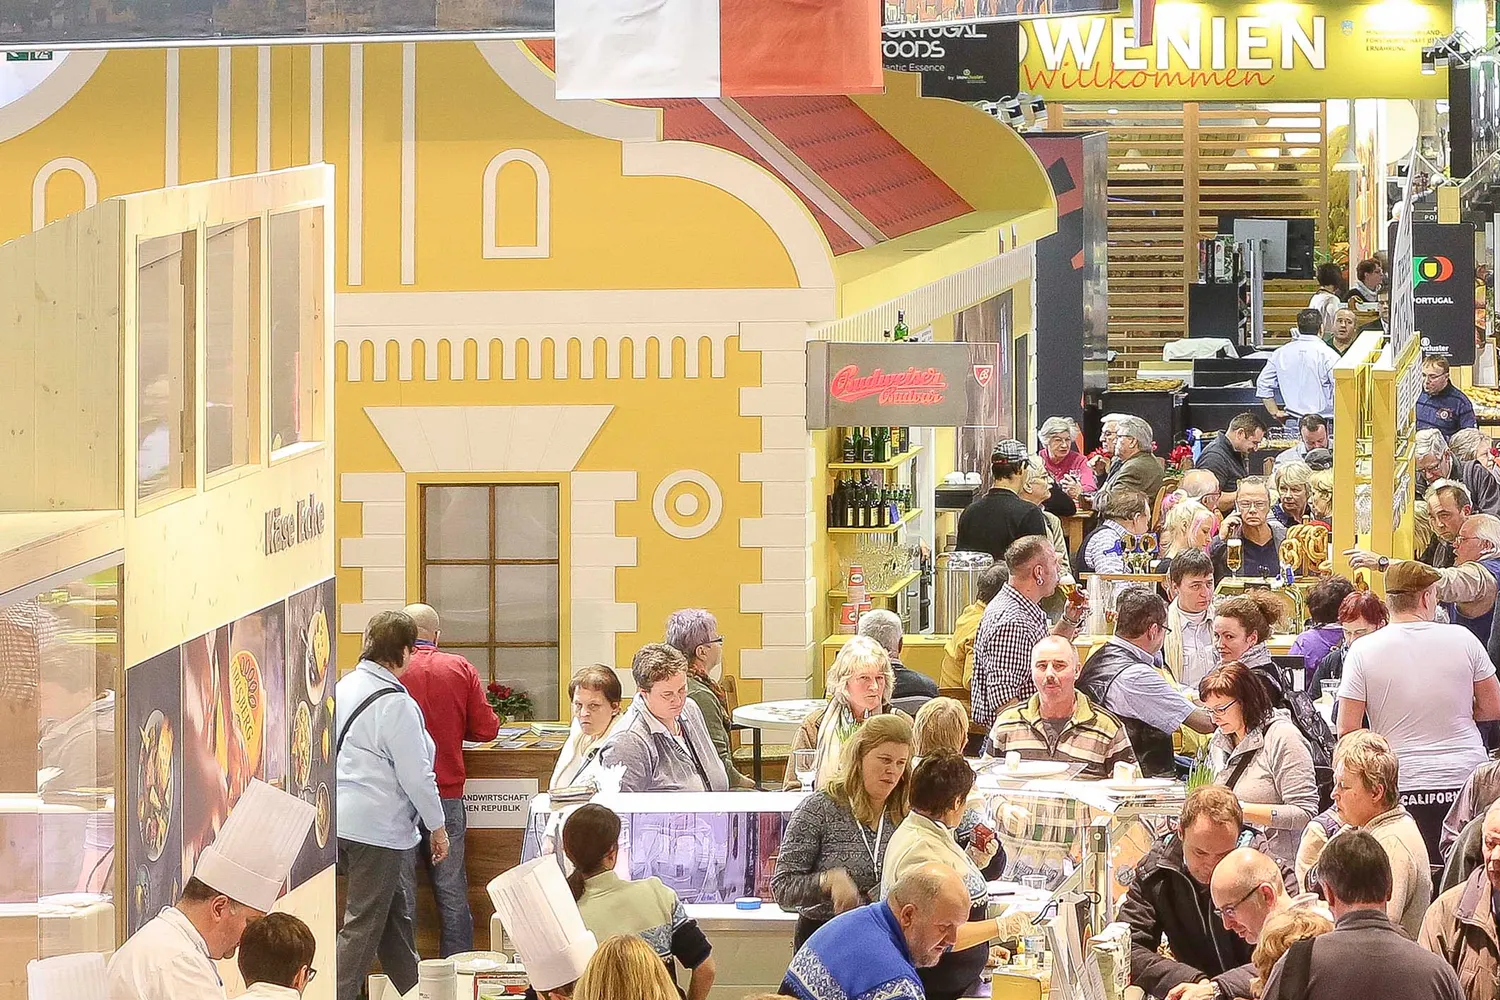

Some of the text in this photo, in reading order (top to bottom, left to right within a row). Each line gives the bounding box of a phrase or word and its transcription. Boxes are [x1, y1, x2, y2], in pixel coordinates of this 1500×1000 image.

[886, 25, 987, 38] ORTUGAL
[882, 40, 945, 58] OODS
[909, 63, 945, 72] Essence
[1022, 61, 1275, 90] Willkommen
[830, 364, 948, 403] Budweiser
[878, 387, 944, 406] Budvar
[265, 507, 295, 556] Käse
[465, 804, 521, 812] HEN REPUBLIK
